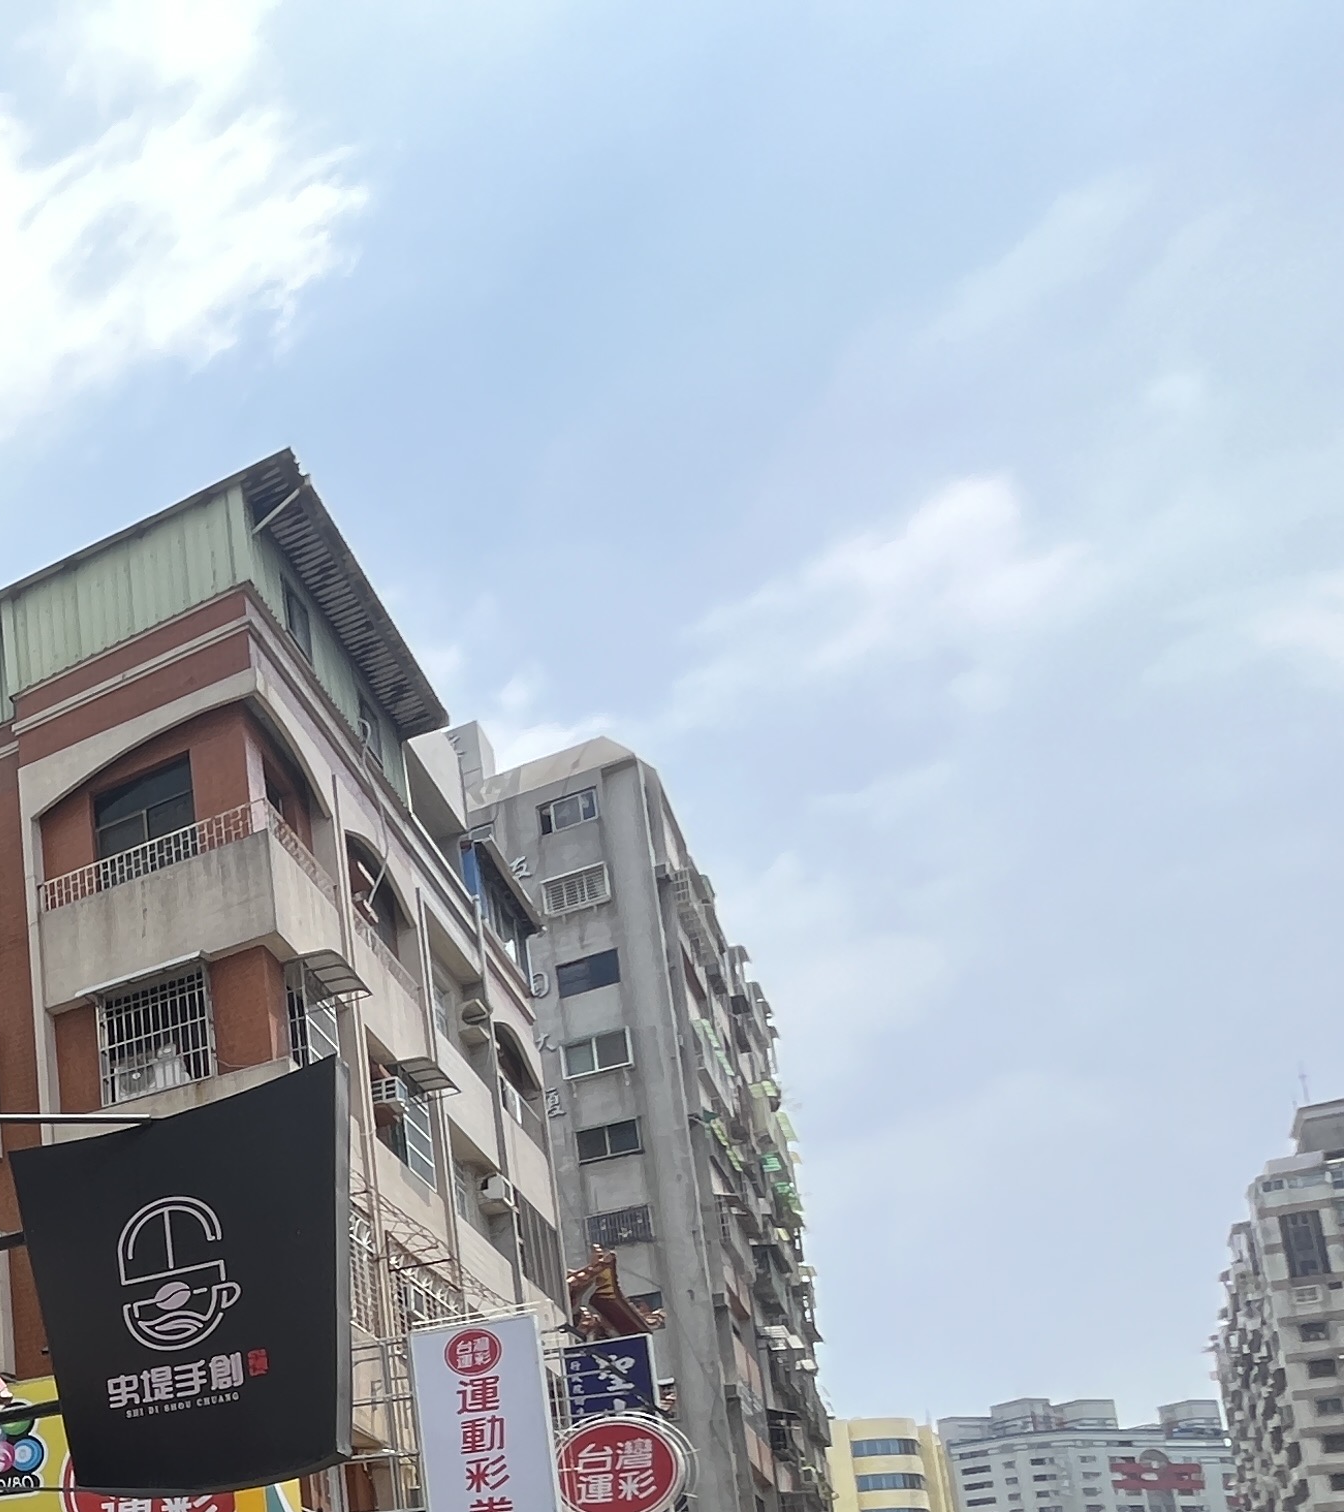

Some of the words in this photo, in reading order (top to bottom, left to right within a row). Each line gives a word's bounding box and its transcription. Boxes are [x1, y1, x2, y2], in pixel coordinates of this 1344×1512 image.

[126, 1406, 144, 1418] SHI
[149, 1405, 159, 1415] DI
[164, 1400, 191, 1412] SHOU
[196, 1391, 240, 1407] CHUANG
[577, 1437, 653, 1473] 台灣
[577, 1469, 657, 1504] 運彩
